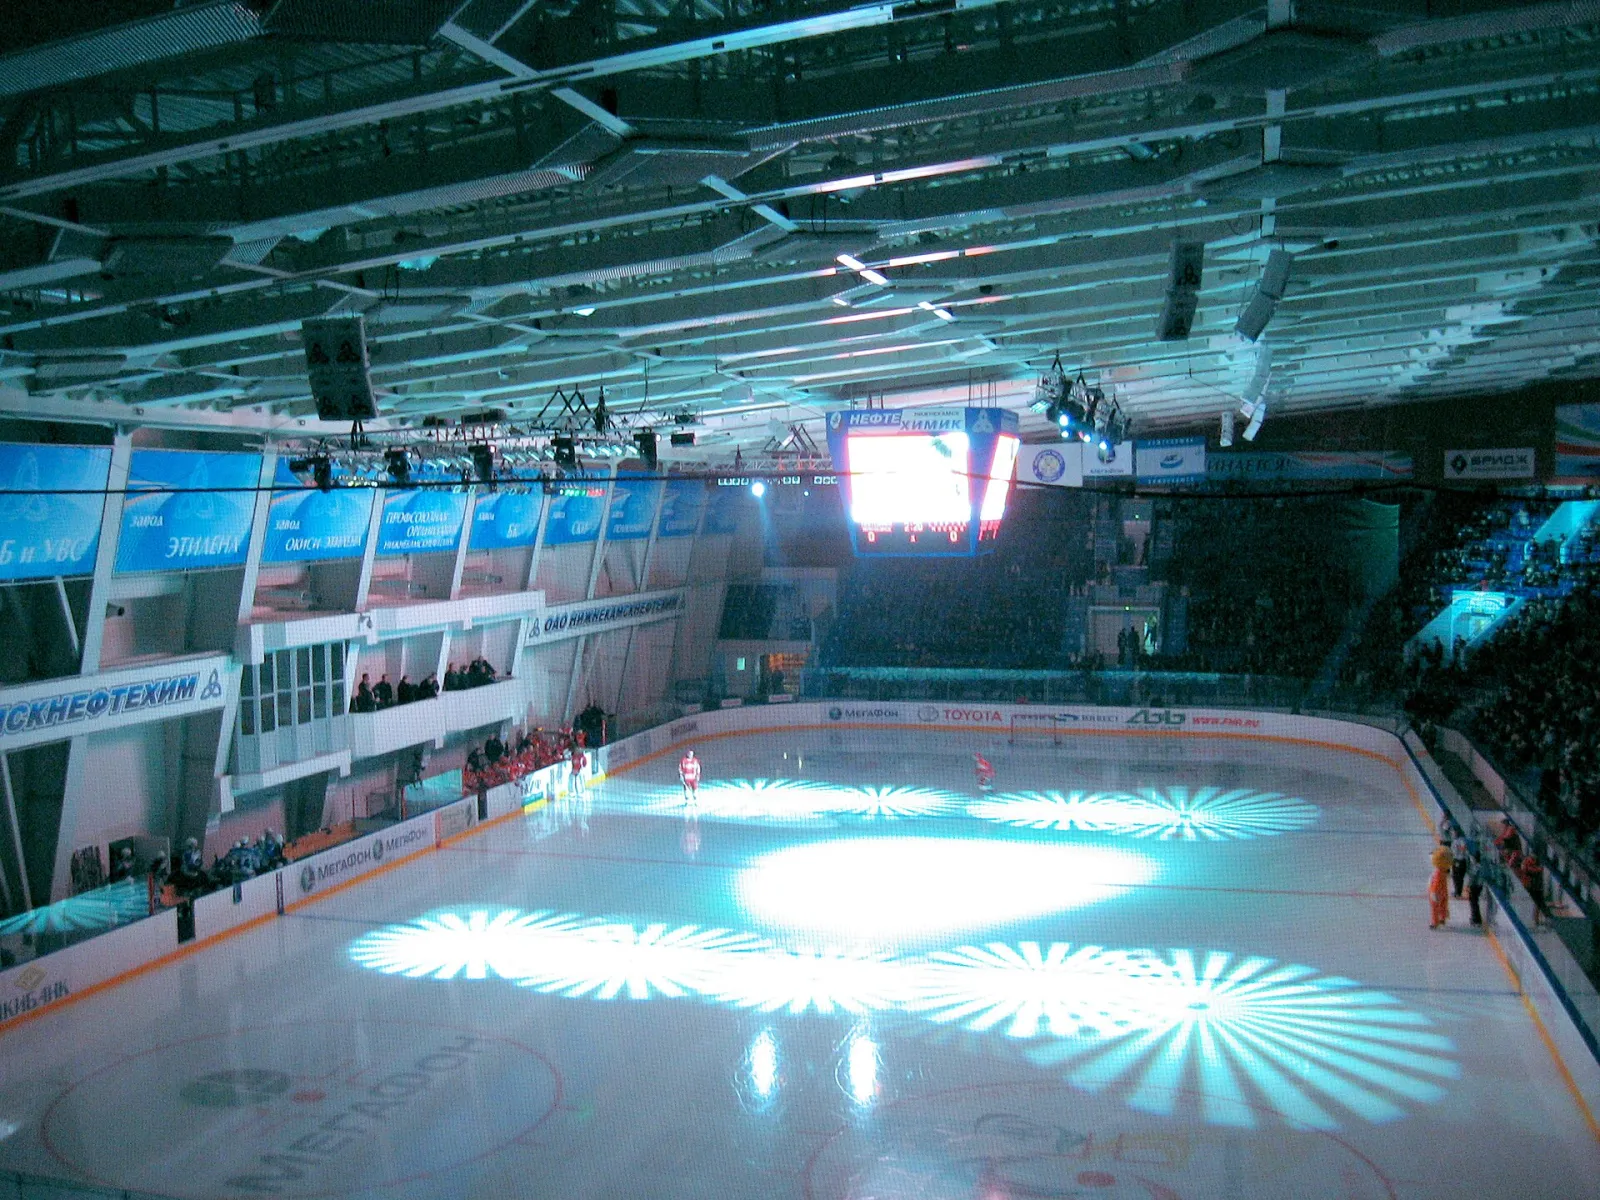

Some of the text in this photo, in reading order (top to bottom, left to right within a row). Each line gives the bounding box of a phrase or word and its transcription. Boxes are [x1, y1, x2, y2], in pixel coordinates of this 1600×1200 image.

[850, 413, 900, 425] НЕФТЕ
[900, 420, 961, 430] ХИМИК
[165, 535, 239, 558] ЭТИЛЕНА
[285, 537, 322, 551] ОКИСИ
[544, 615, 568, 632] ОАО
[944, 709, 1002, 722] TOYOTA
[317, 849, 371, 881] МЕГАФОН
